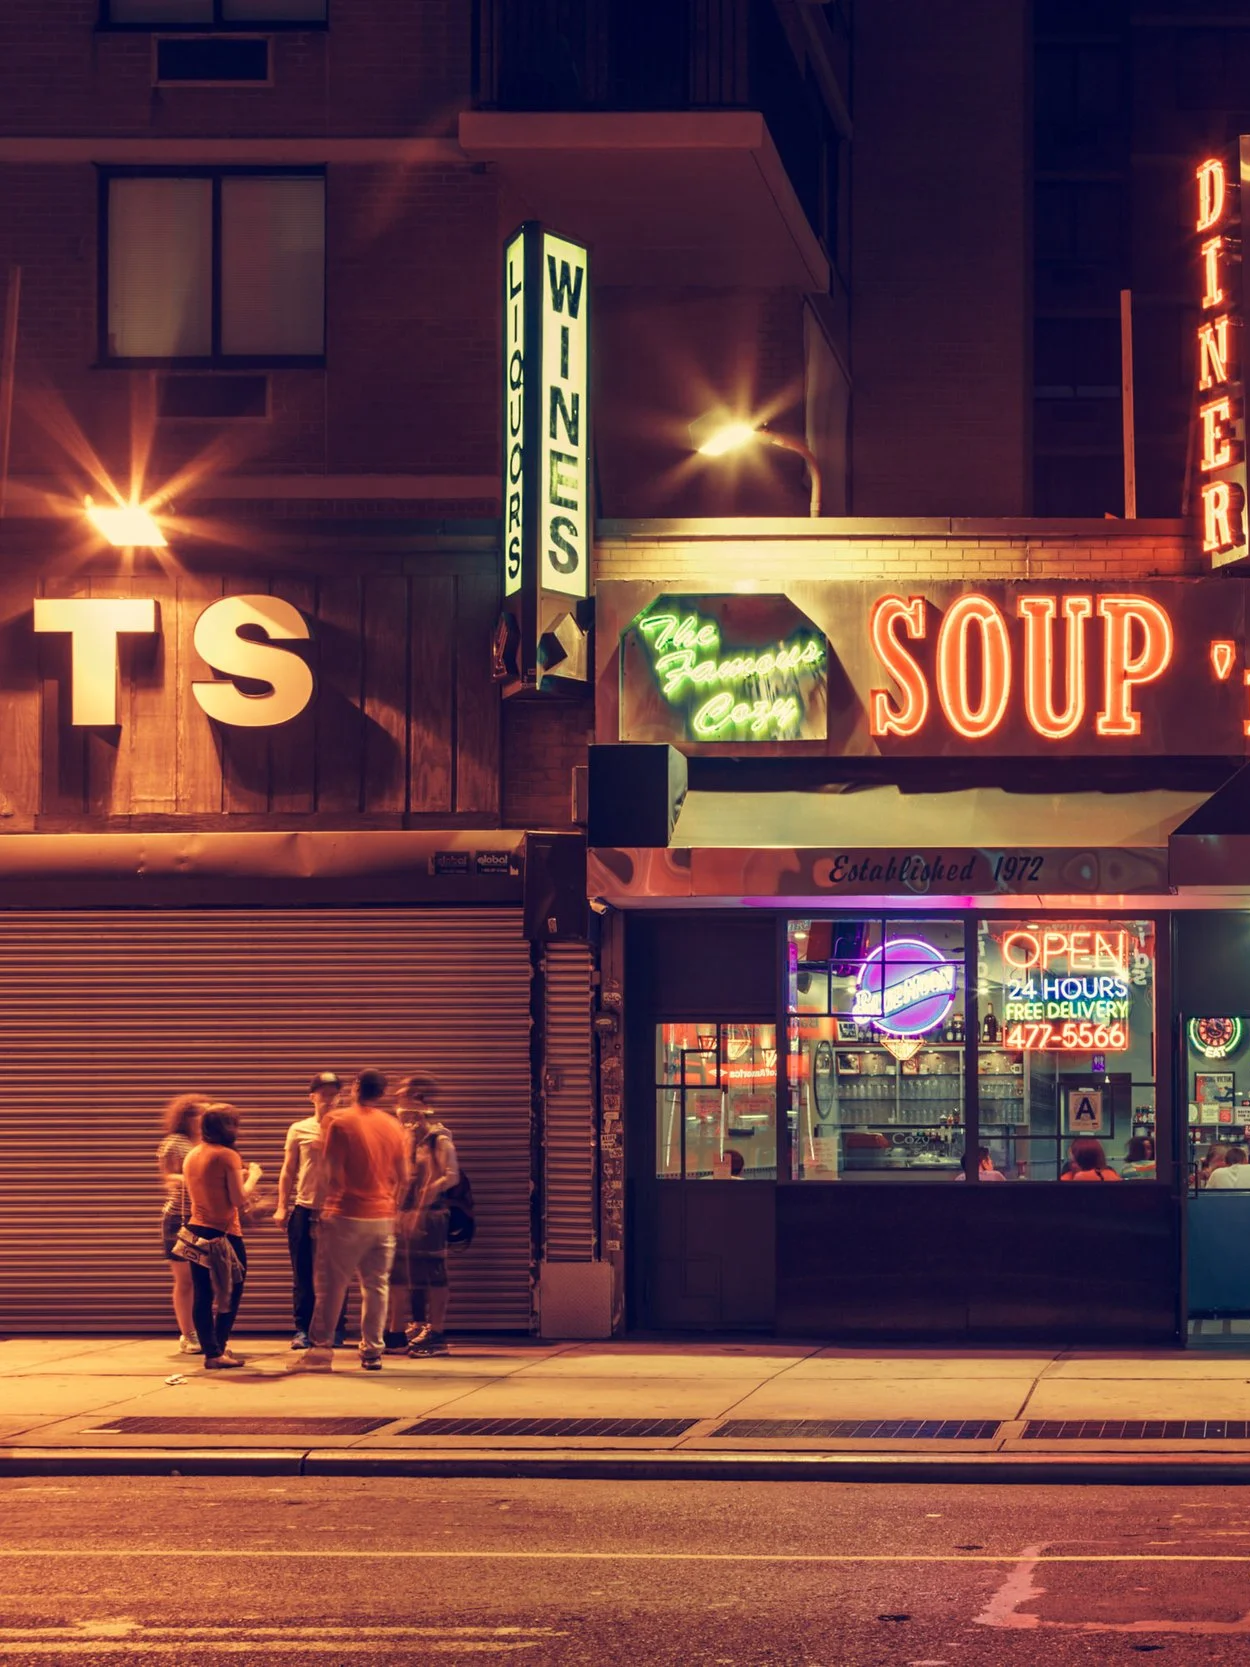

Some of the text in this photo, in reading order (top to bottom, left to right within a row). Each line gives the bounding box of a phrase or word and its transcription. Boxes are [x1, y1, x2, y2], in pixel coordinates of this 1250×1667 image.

[1196, 157, 1232, 552] DINER
[507, 260, 524, 579] LIQUORS
[547, 254, 584, 575] WINES
[639, 614, 717, 650] The
[655, 640, 824, 693] Famous
[870, 593, 1174, 738] SOUP
[693, 692, 798, 734] Cozy
[829, 854, 1044, 883] Established 1972
[1003, 932, 1124, 969] OPEN
[1008, 977, 1128, 1001] 24 HOURS
[1005, 1000, 1129, 1021] FREE DELIVERY
[1007, 1023, 1126, 1049] 477-5566
[1205, 1046, 1226, 1058] EAT
[1075, 1097, 1096, 1120] A
[892, 1132, 930, 1147] Cozy
